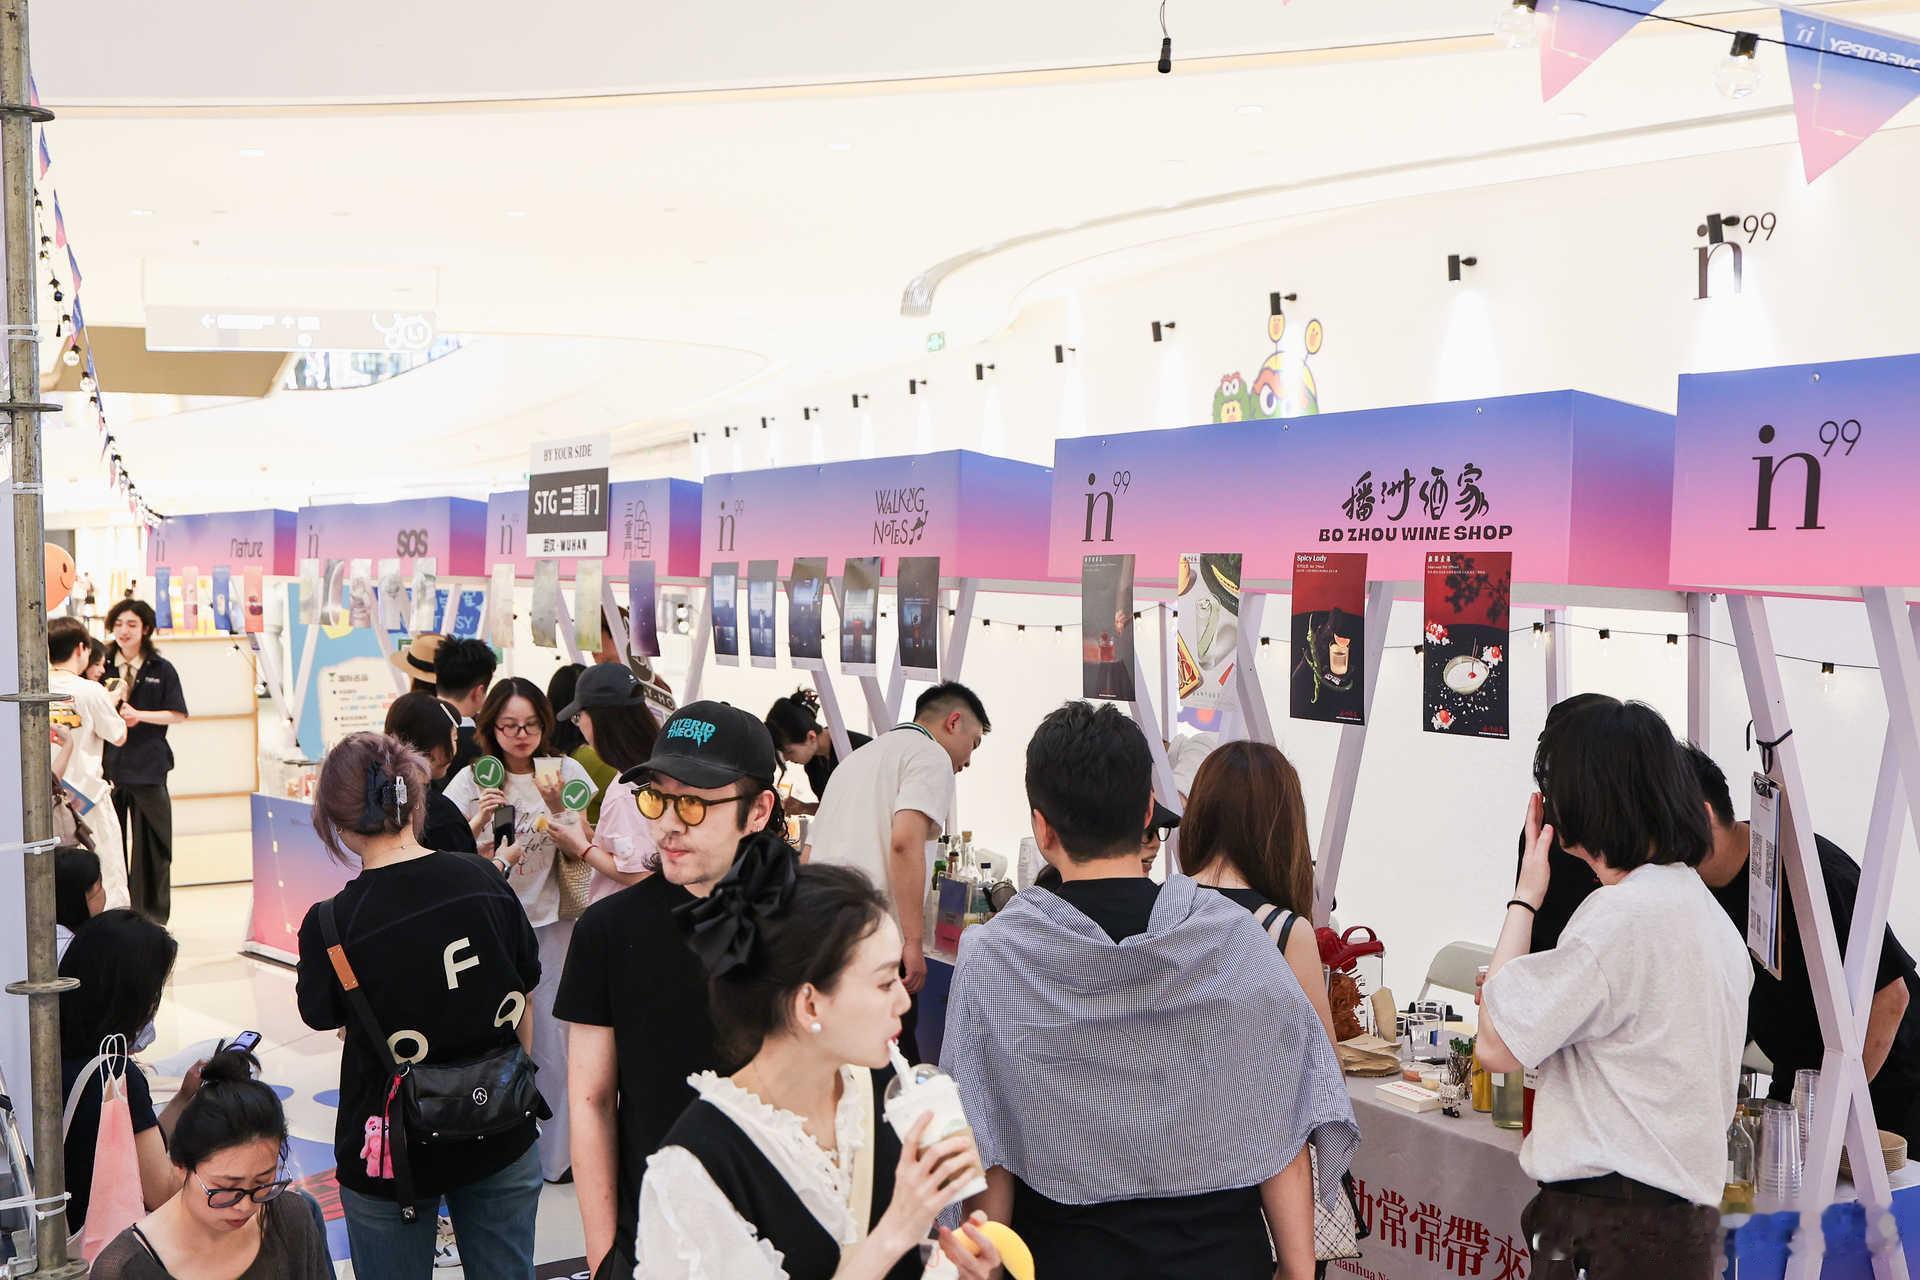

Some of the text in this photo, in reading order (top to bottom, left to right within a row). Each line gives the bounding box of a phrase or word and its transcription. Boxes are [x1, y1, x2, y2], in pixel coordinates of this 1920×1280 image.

[555, 446, 573, 461] YOUR
[575, 443, 593, 458] SIDE
[534, 489, 558, 516] STG
[1318, 525, 1513, 542] BO ZHOU WINE SHOP
[397, 528, 428, 558] SOS
[561, 538, 587, 552] WUHAN
[1296, 554, 1327, 563] Spicy Lady
[670, 718, 716, 733] HYBRID
[667, 727, 713, 749] THEORY
[443, 937, 480, 990] F
